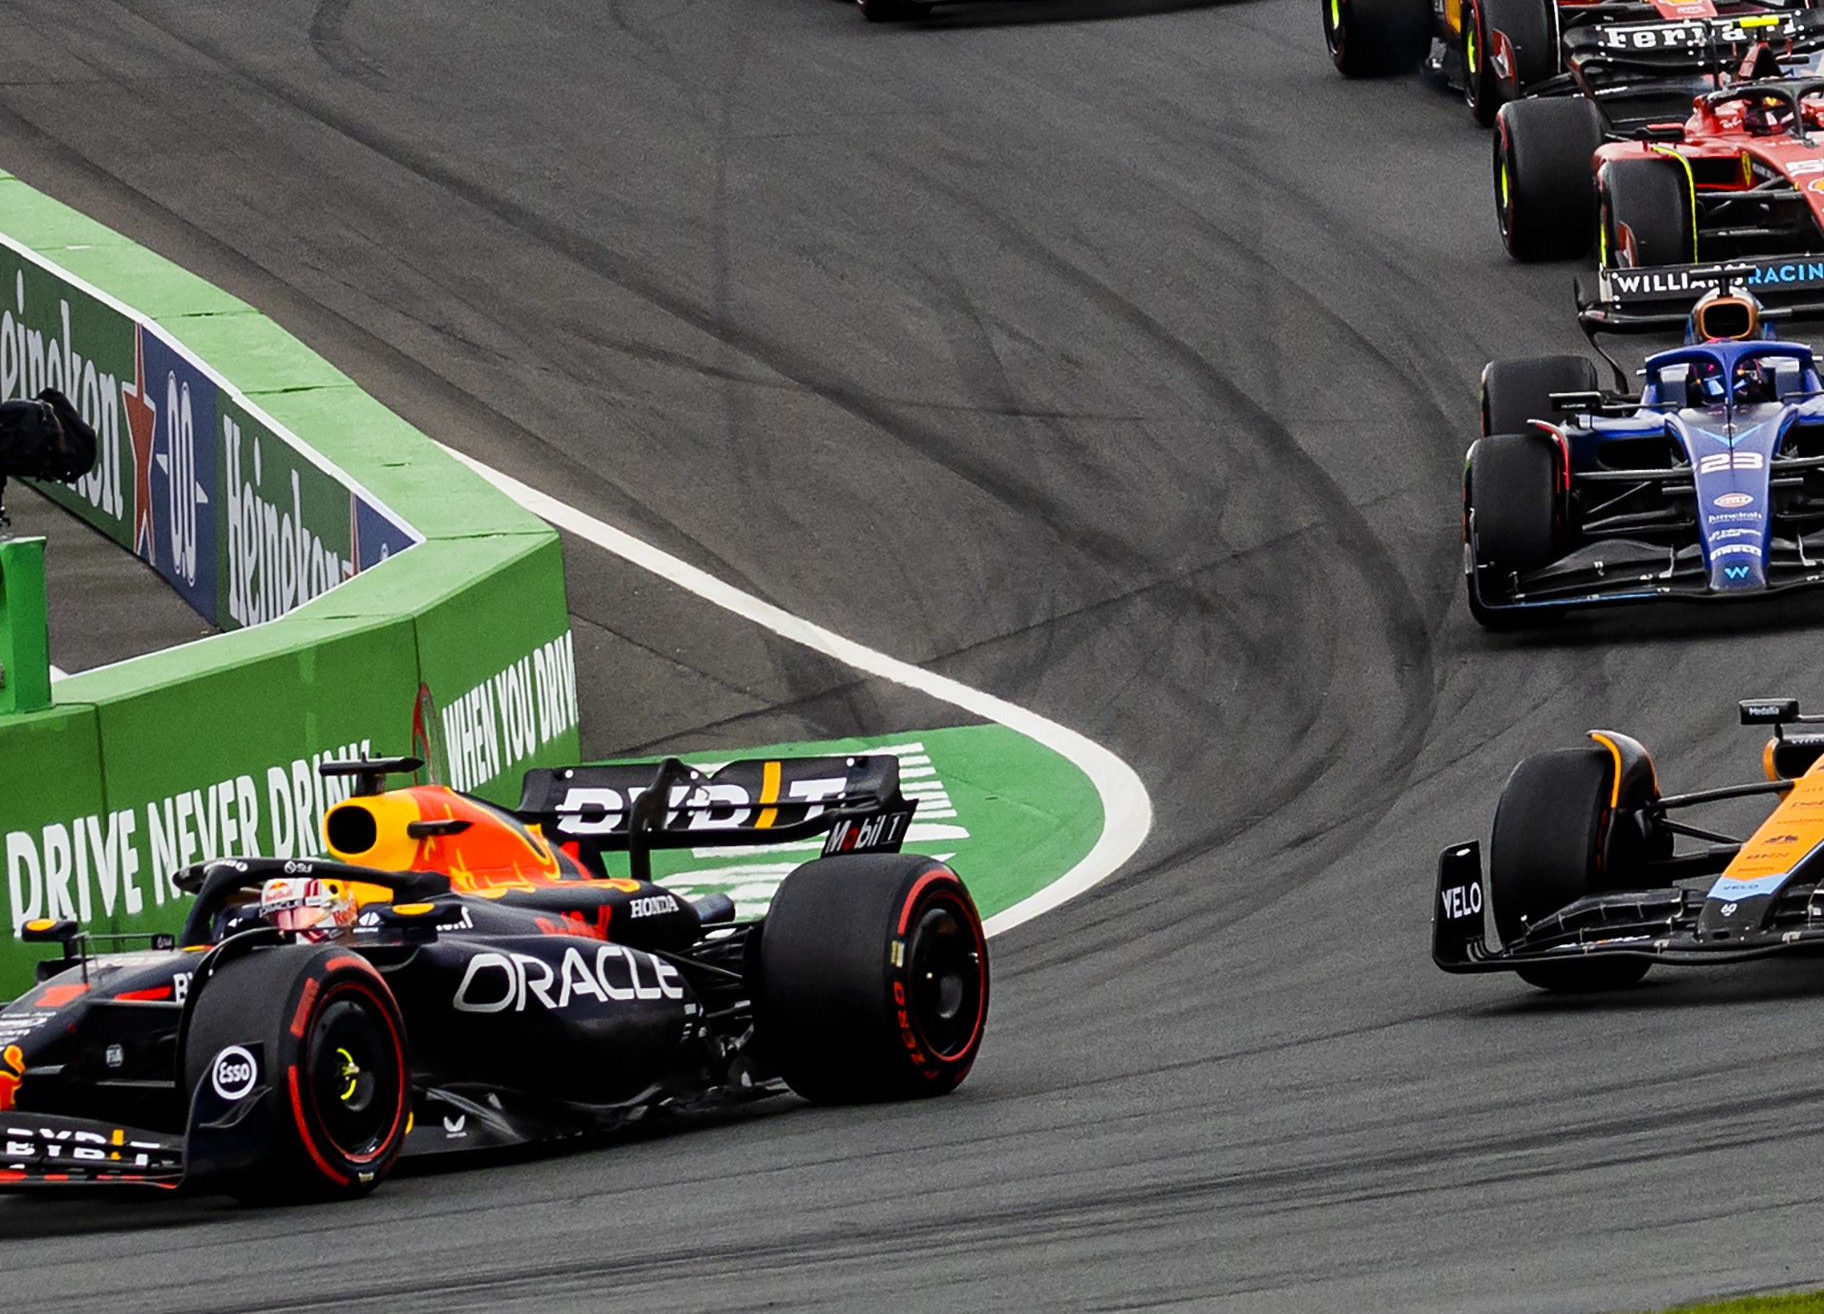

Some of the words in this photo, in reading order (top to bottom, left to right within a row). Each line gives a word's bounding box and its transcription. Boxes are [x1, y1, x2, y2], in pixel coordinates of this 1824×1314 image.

[1604, 14, 1797, 48] Ferai
[1701, 452, 1764, 474] 23
[441, 679, 501, 794] WHEN
[498, 655, 537, 763] YOU
[534, 628, 579, 744] DRIV
[825, 814, 885, 854] Mobil
[885, 816, 897, 843] 1
[5, 809, 143, 938] DRIVE
[147, 774, 261, 906] NEVER
[630, 894, 679, 919] HONDA
[1441, 881, 1483, 919] VELO
[452, 944, 684, 1014] ORACLE
[219, 1061, 250, 1084] Esso
